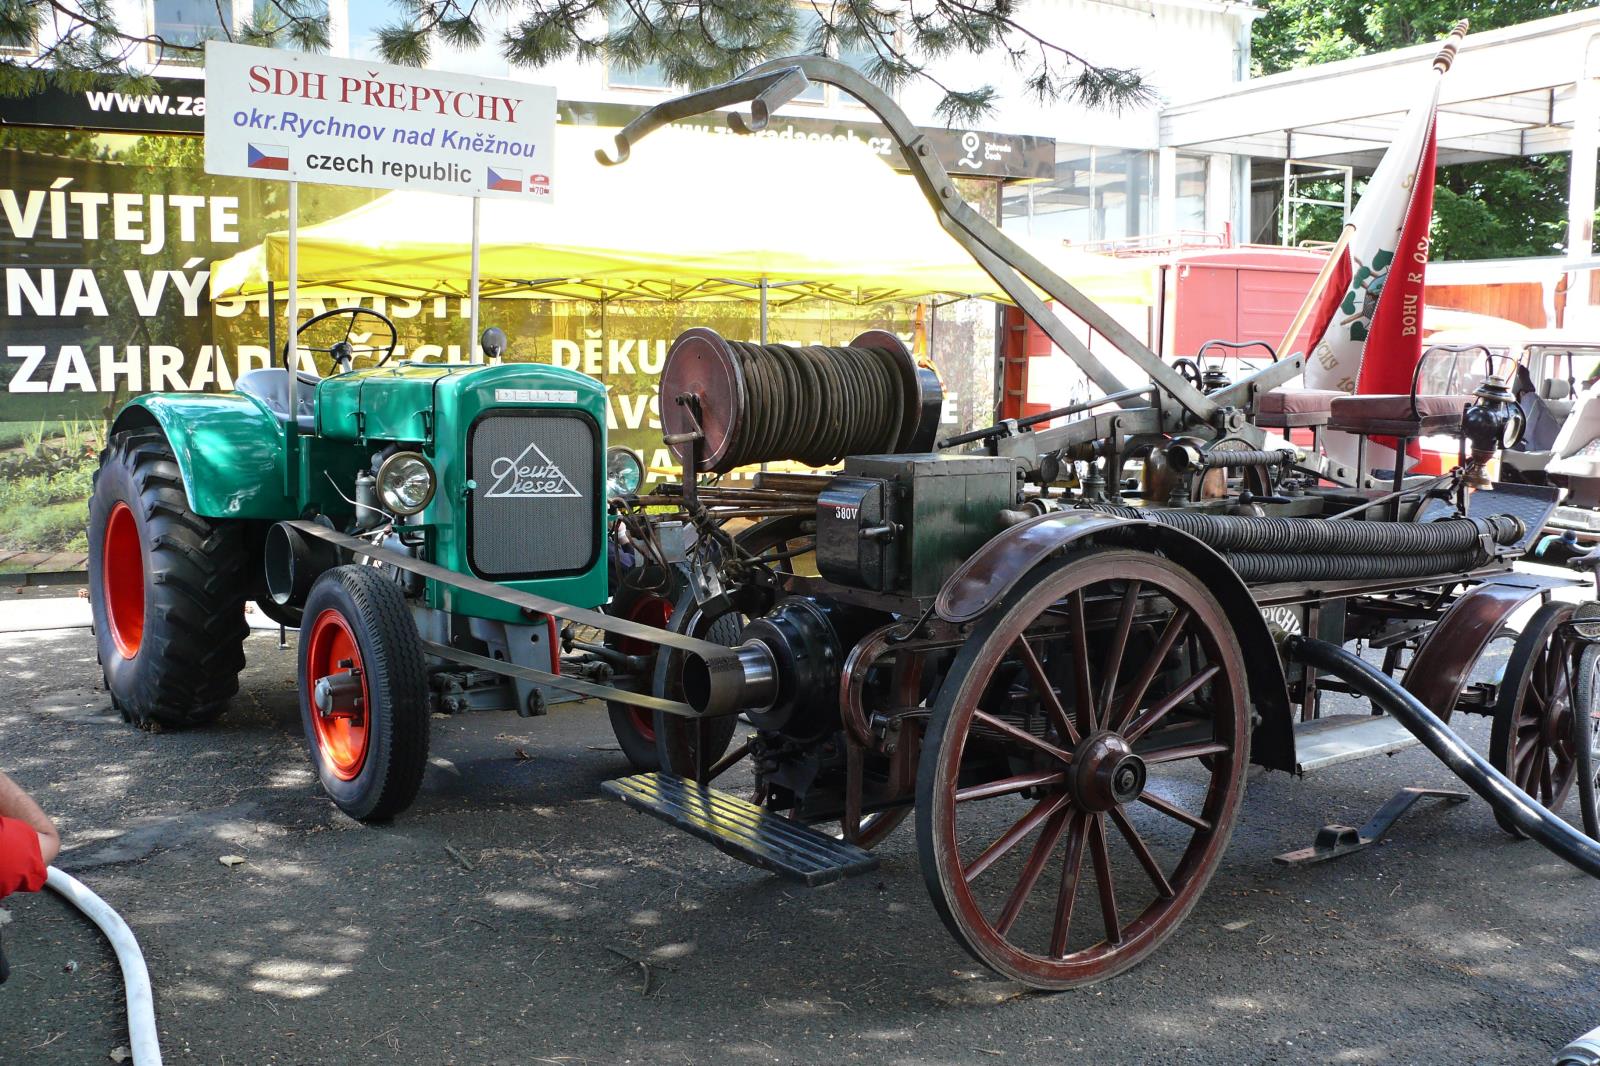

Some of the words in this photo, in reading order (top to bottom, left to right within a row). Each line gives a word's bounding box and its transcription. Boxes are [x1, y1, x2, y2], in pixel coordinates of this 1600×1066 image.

[249, 65, 328, 100] SDH
[338, 71, 524, 123] PŘEPYCHY
[233, 108, 386, 138] okr.Rychnov
[392, 127, 436, 147] nad
[441, 130, 536, 158] Kněžnou
[306, 154, 373, 174] czech
[382, 161, 472, 183] republic
[0, 177, 240, 255] VÍTEJTE
[6, 268, 109, 316] NA
[835, 506, 858, 520] 380V
